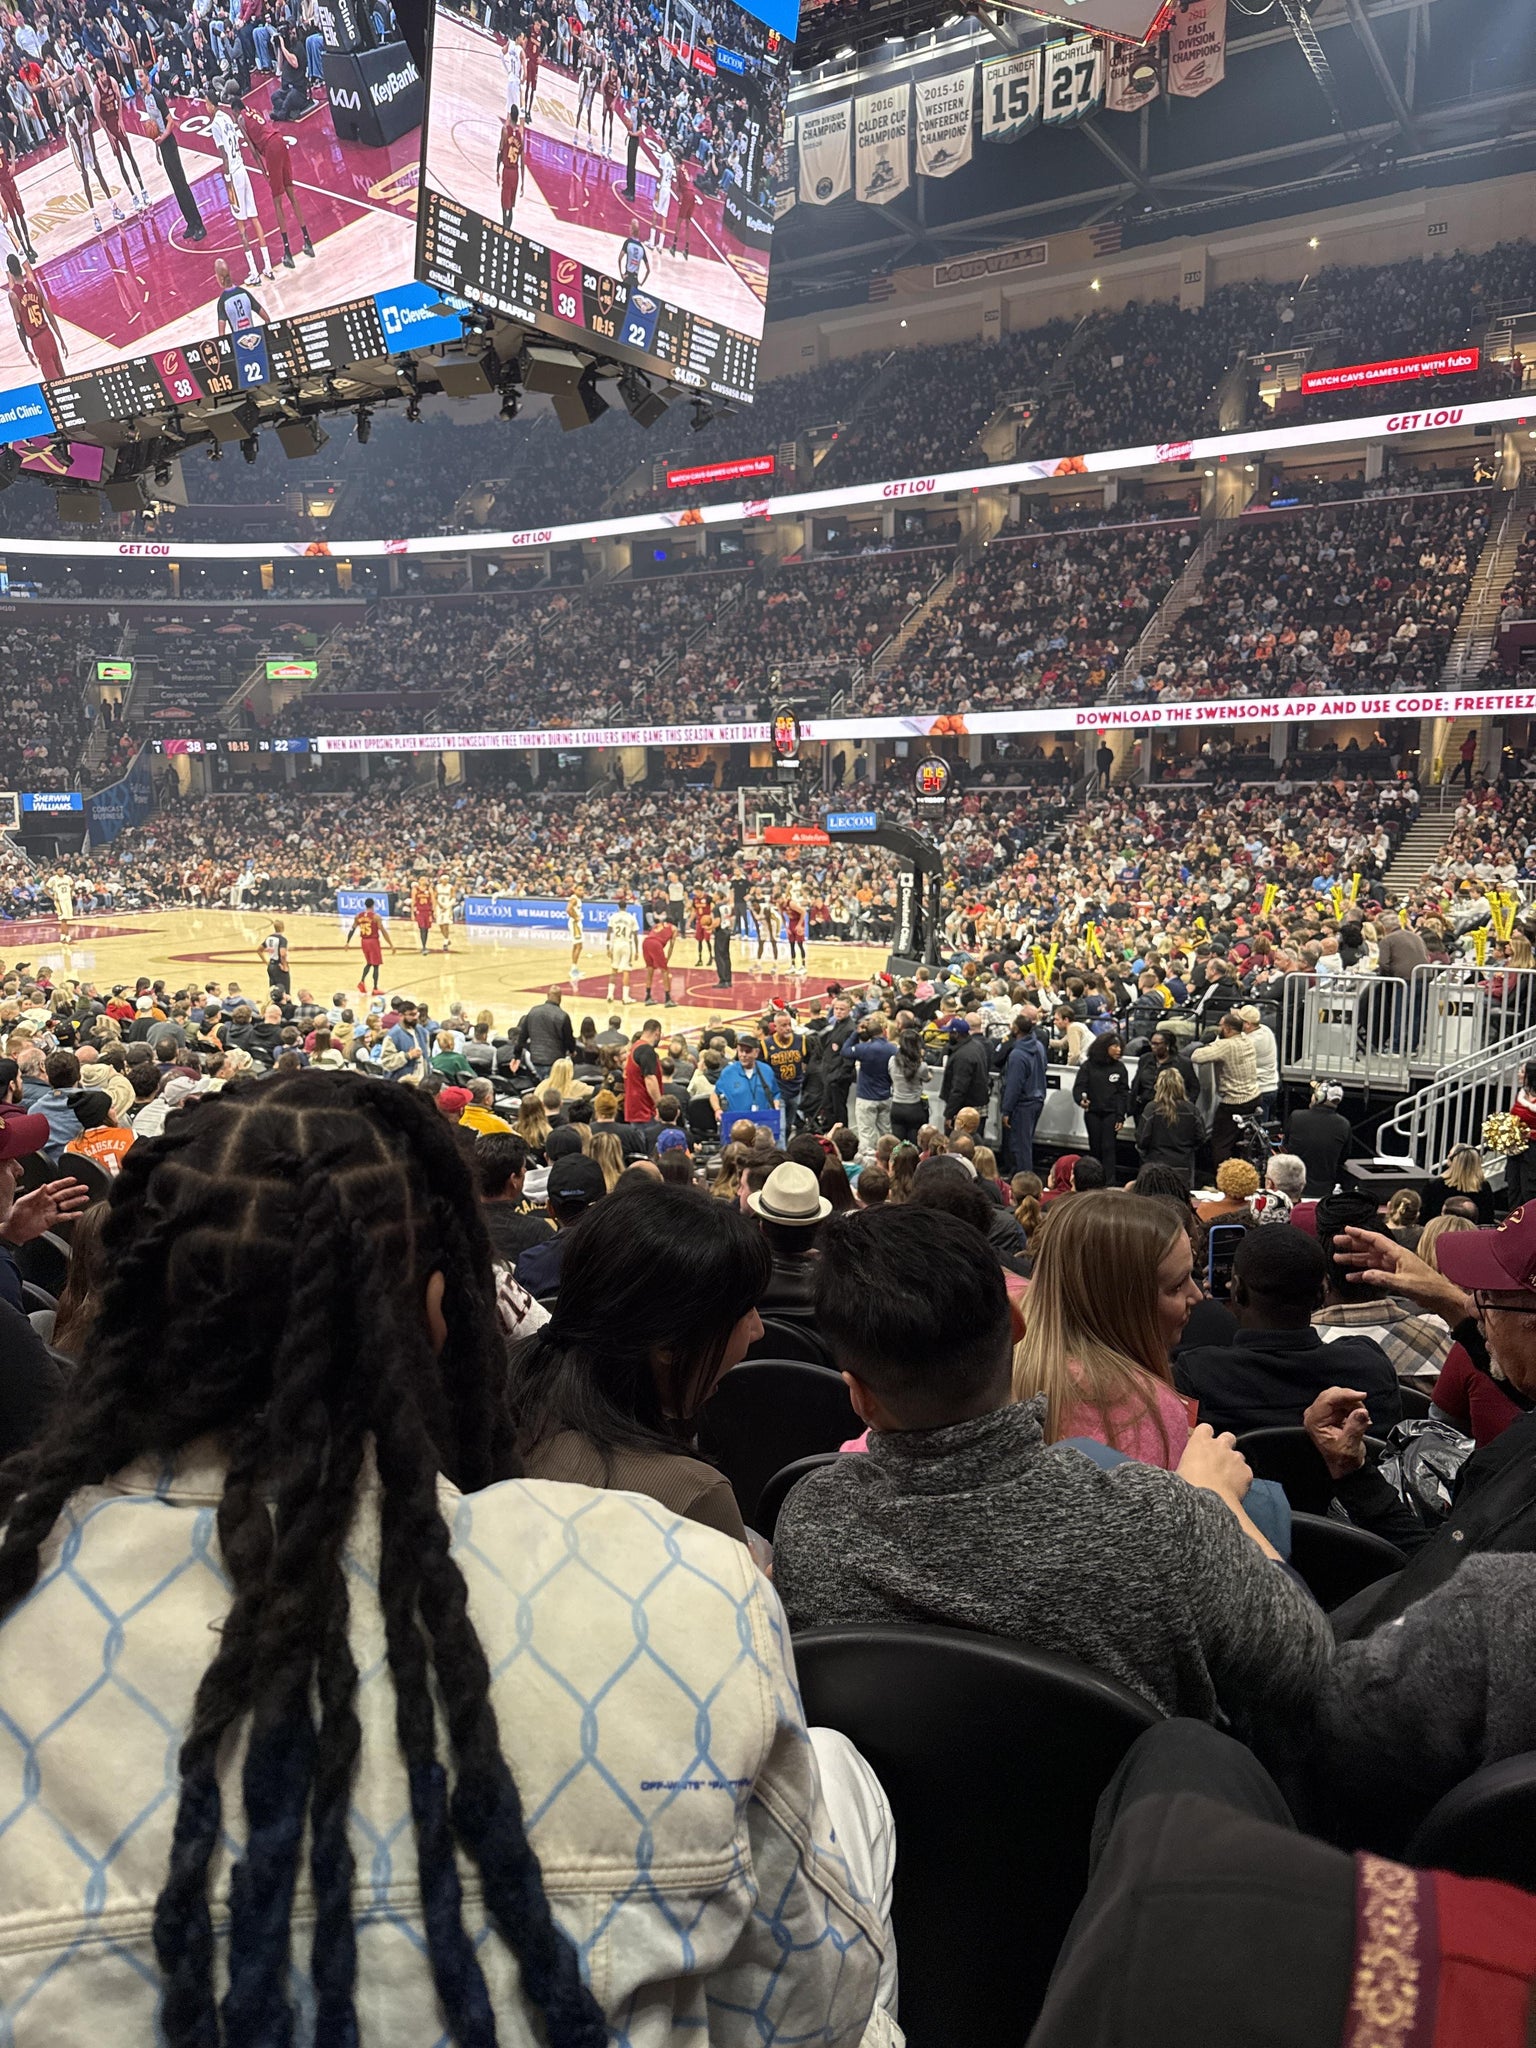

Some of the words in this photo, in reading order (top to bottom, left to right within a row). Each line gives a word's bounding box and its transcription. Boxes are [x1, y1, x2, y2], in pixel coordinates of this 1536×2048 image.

[1187, 21, 1207, 36] EAST
[1179, 31, 1216, 50] DIVISION
[1172, 42, 1221, 64] CHAMPIONS
[987, 59, 1035, 81] CALLANDER
[370, 61, 420, 106] KeyBank
[924, 81, 965, 101] 2015-16
[1052, 59, 1095, 110] 27
[870, 96, 894, 113] 2016
[925, 97, 964, 116] WESTERN
[992, 76, 1029, 125] 15
[804, 118, 820, 128] NORTH
[821, 111, 845, 125] DIVISION
[858, 114, 889, 134] CALDER
[890, 109, 907, 125] CUP
[918, 109, 970, 132] CONFERENCE
[802, 119, 847, 141] CHAMPIONS
[858, 124, 906, 149] CHAMPIONS
[920, 124, 968, 146] CHAMPIONS
[439, 209, 462, 226] BRYANT
[1429, 224, 1447, 234] 211
[437, 232, 457, 248] TYSON
[436, 244, 454, 259] WADE
[435, 256, 463, 275] MITCHELL
[615, 285, 627, 304] 24
[27, 304, 43, 328] 45
[498, 299, 536, 324] RAFFLE
[558, 293, 576, 318] 38
[592, 315, 615, 337] 10:15
[628, 323, 646, 347] 22
[218, 339, 231, 355] 24
[174, 379, 193, 398] 38
[207, 375, 233, 393] 10:15
[244, 362, 263, 382] 22
[1307, 373, 1340, 388] WATCH
[1340, 371, 1365, 383] CAVS
[1365, 367, 1399, 379] GAMES
[1400, 364, 1420, 375] LIVE
[1421, 361, 1446, 371] WITH
[1447, 356, 1472, 368] fubo
[18, 403, 43, 419] Clinic
[1386, 414, 1421, 432] GET
[1424, 409, 1464, 428] LOU
[883, 483, 906, 497] GET
[909, 479, 936, 494] LOU
[512, 533, 531, 545] GET
[532, 531, 552, 542] LOU
[119, 545, 142, 554] GET
[145, 545, 170, 555] LOU
[1076, 709, 1162, 725] DOWNLOAD
[1166, 708, 1192, 721] THE
[1196, 704, 1279, 719] SWENSONS
[1284, 703, 1316, 716] APP
[1321, 701, 1356, 715] AND
[1361, 700, 1390, 713] USE
[1395, 698, 1449, 712] CODE:
[186, 741, 201, 752] 38
[227, 741, 250, 752] 10:15
[274, 740, 289, 752] 22
[326, 739, 347, 750] WHEN
[349, 739, 362, 749] ANY
[364, 738, 394, 749] OPPOSING
[395, 737, 416, 749] PLAYER
[457, 735, 500, 747] CONSECUTIVE
[501, 735, 517, 746] FREE
[519, 734, 546, 746] THROWS
[549, 733, 573, 745] DURING
[575, 733, 580, 744] A
[582, 731, 618, 744] CAVALIERS
[621, 731, 641, 742] HOME
[643, 730, 663, 742] GAME
[665, 729, 681, 741] THIS
[684, 727, 716, 741] SEASON.
[719, 727, 740, 740] NEXT
[742, 726, 758, 739] DAY
[923, 767, 945, 778] 10:15
[923, 778, 941, 791] 24
[33, 794, 70, 802] SHERWIN
[92, 806, 124, 814] COMCAST
[830, 816, 874, 828] LECOM
[340, 896, 386, 911] LECM
[468, 904, 512, 918] LECOM
[516, 909, 528, 917] WE
[529, 909, 549, 918] MAKE
[902, 887, 911, 928] Cleveland
[615, 926, 627, 937] 24
[780, 1064, 796, 1080] 23
